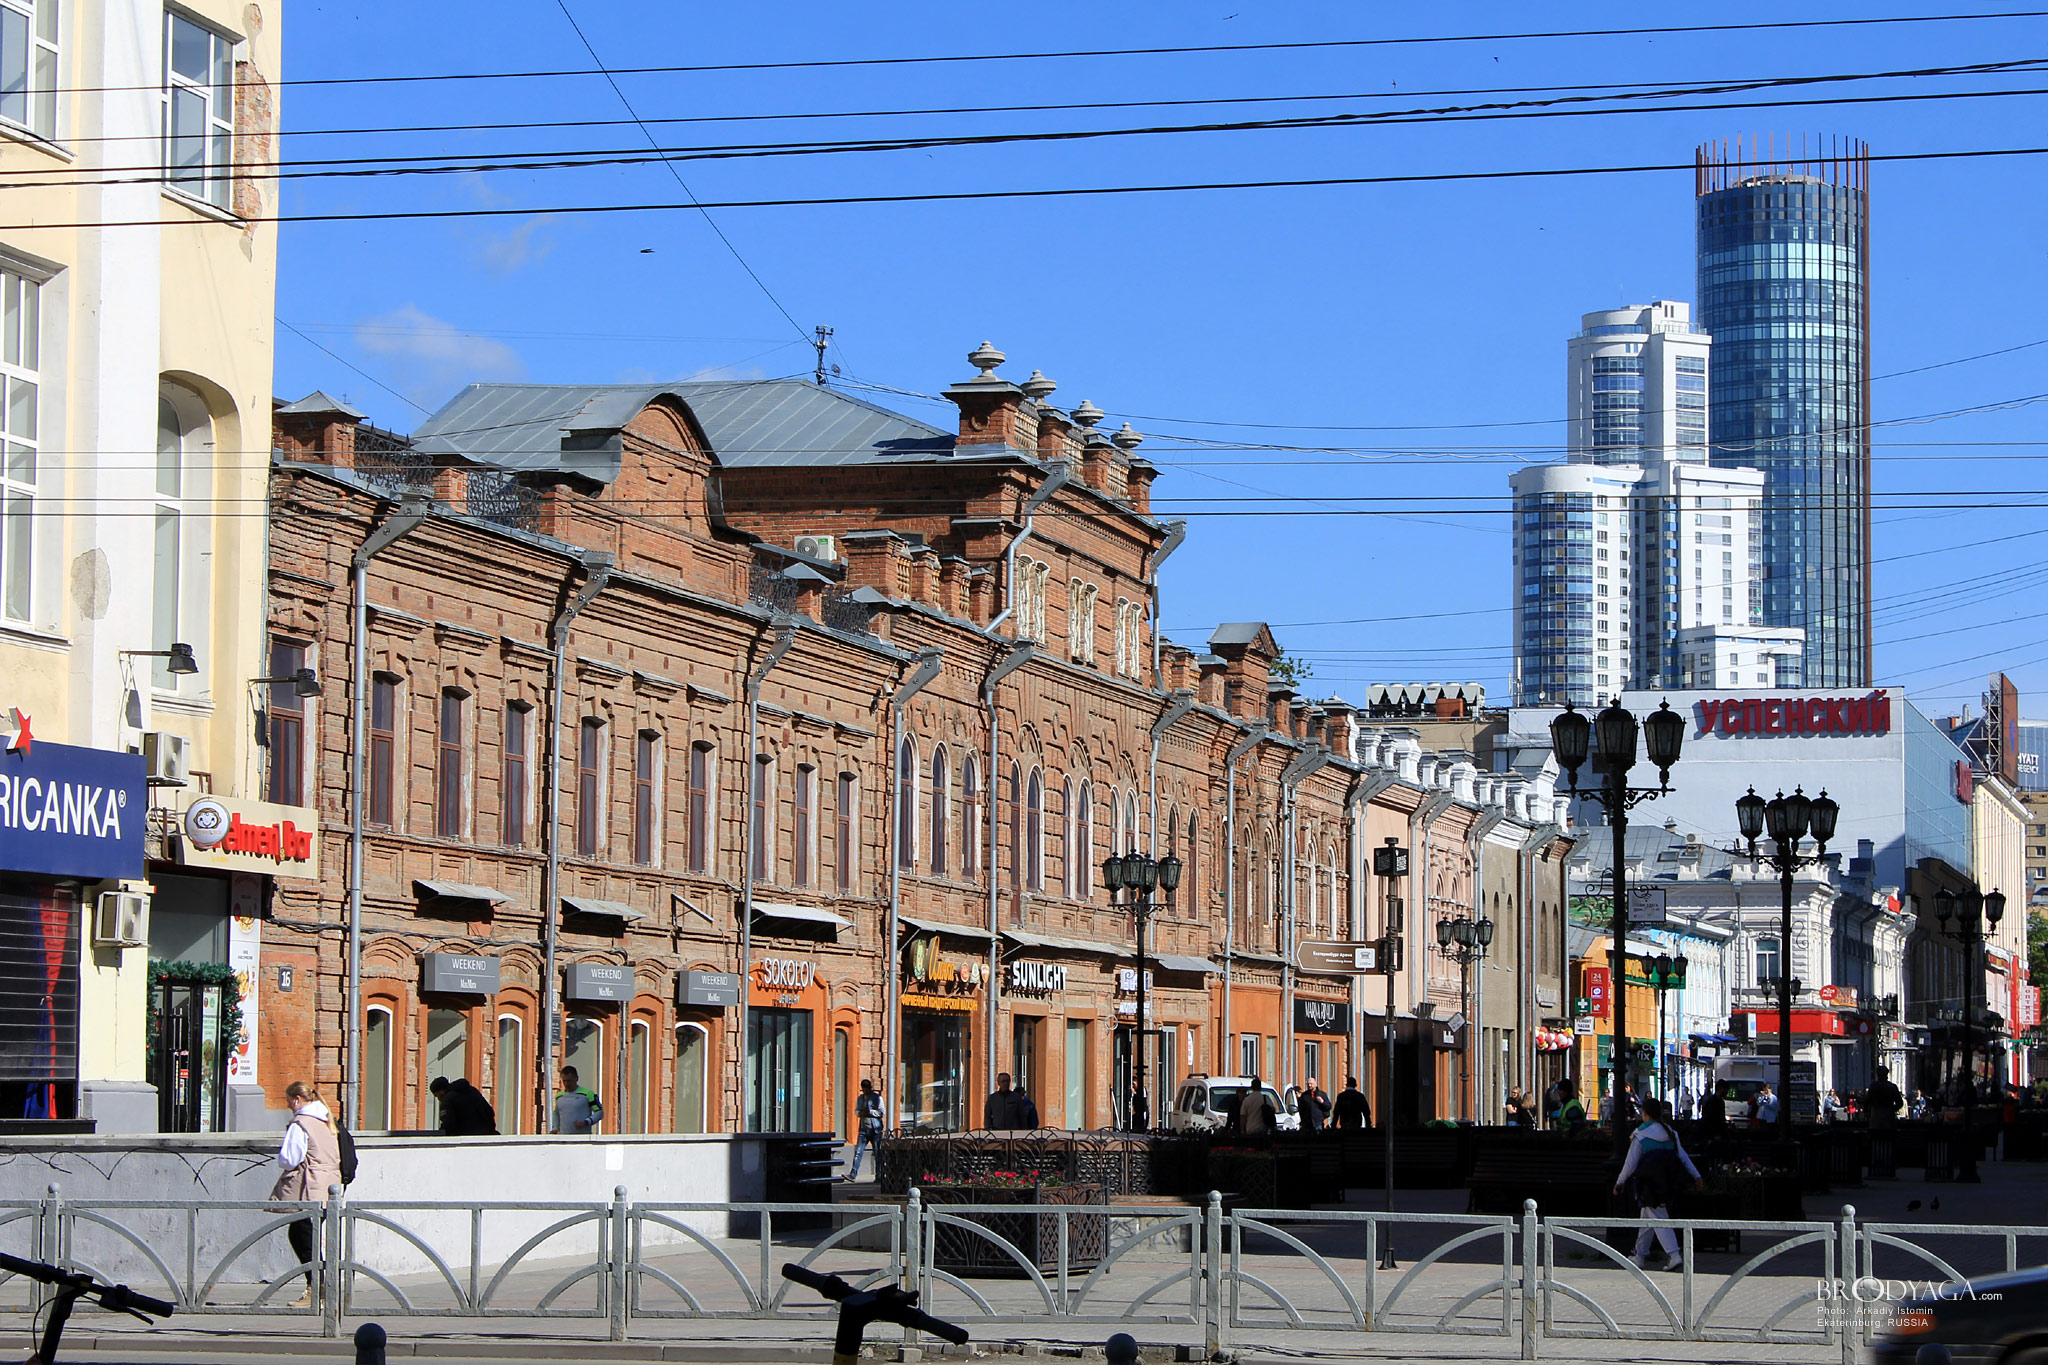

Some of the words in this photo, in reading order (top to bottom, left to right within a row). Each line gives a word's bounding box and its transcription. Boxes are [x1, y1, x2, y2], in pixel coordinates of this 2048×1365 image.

[1700, 690, 1891, 733] УСПЕНСКИЙ
[282, 820, 313, 860] Bar
[451, 958, 487, 971] WEEKEND
[590, 968, 622, 980] WEEKEND
[764, 957, 816, 987] SOKOLOV
[1012, 961, 1068, 990] SUNLIGHT
[281, 971, 291, 987] 16
[701, 975, 728, 986] WEEKEND
